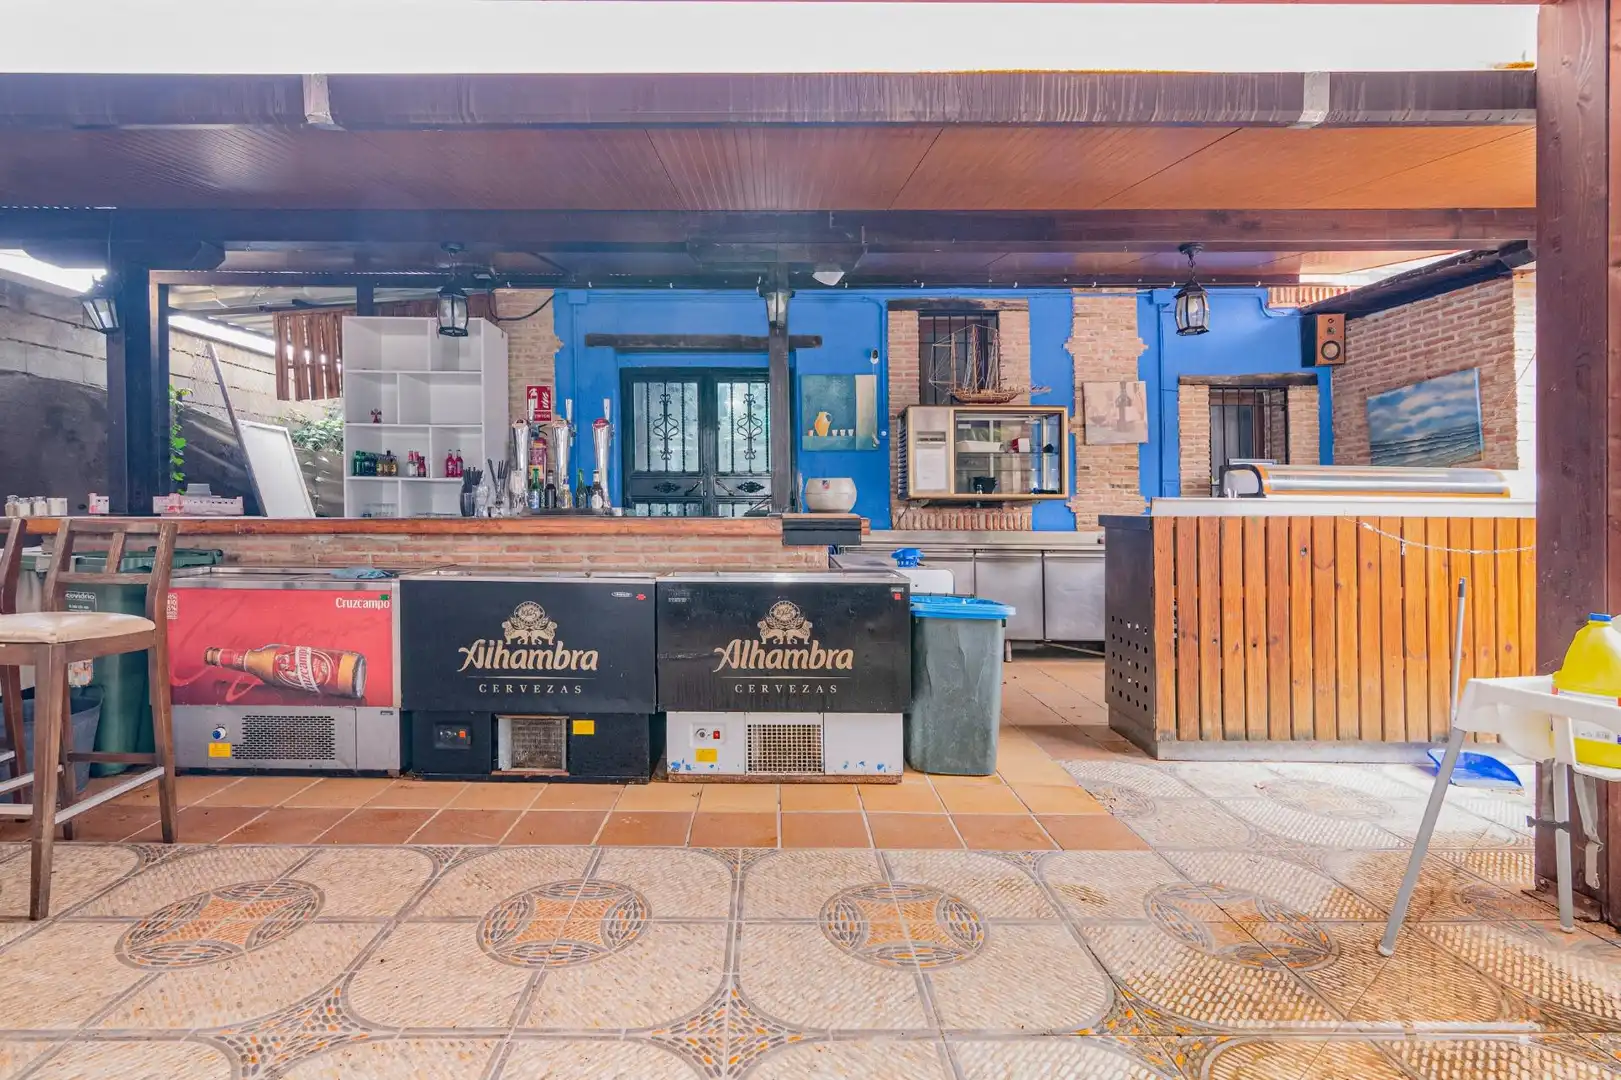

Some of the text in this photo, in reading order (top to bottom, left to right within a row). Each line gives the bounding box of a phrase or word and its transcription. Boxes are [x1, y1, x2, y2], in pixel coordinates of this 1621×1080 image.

[65, 592, 95, 600] covidrio
[336, 597, 390, 610] Cruzcampo
[457, 639, 599, 672] Alhambra
[713, 639, 854, 672] Alhambra
[478, 683, 582, 694] CERVEZAS
[734, 684, 837, 693] CERVEZAS
